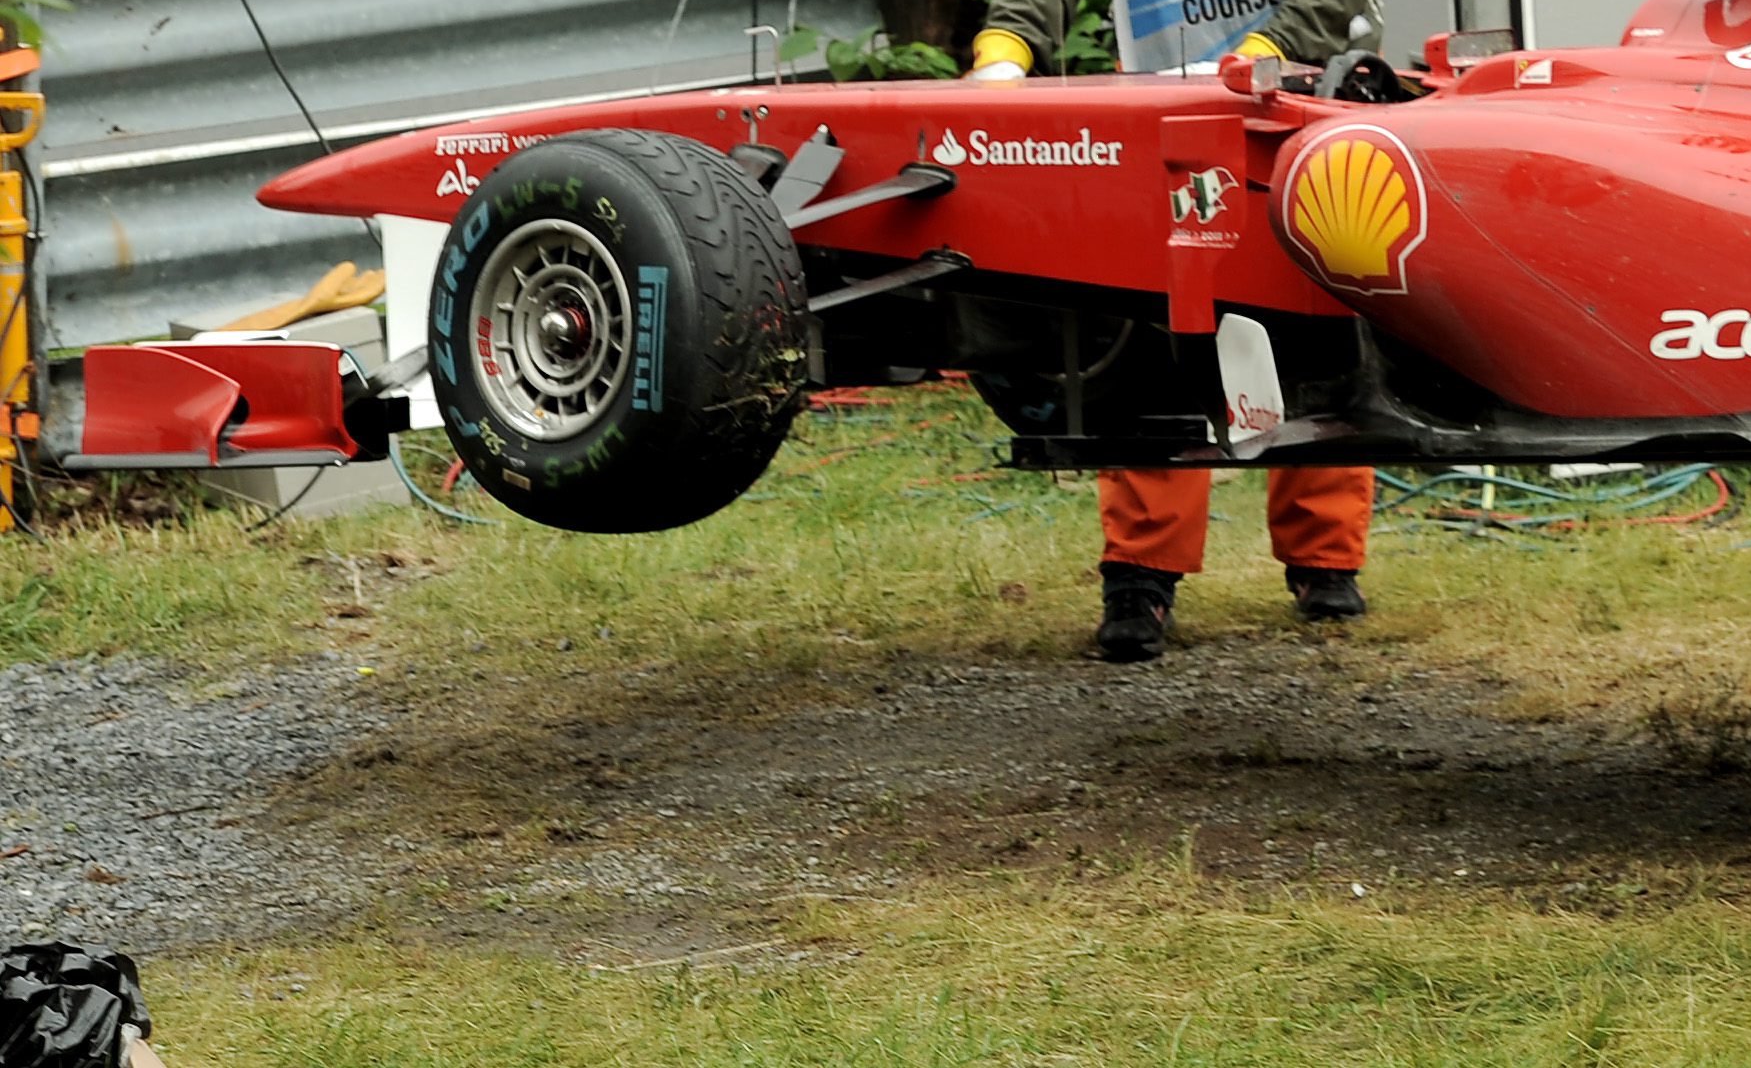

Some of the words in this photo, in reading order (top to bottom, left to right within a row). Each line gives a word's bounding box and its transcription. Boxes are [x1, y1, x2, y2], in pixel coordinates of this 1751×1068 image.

[434, 132, 510, 156] Ferrari
[968, 128, 1123, 167] Santander
[433, 201, 490, 386] ZERO
[632, 265, 669, 412] PIRELLI
